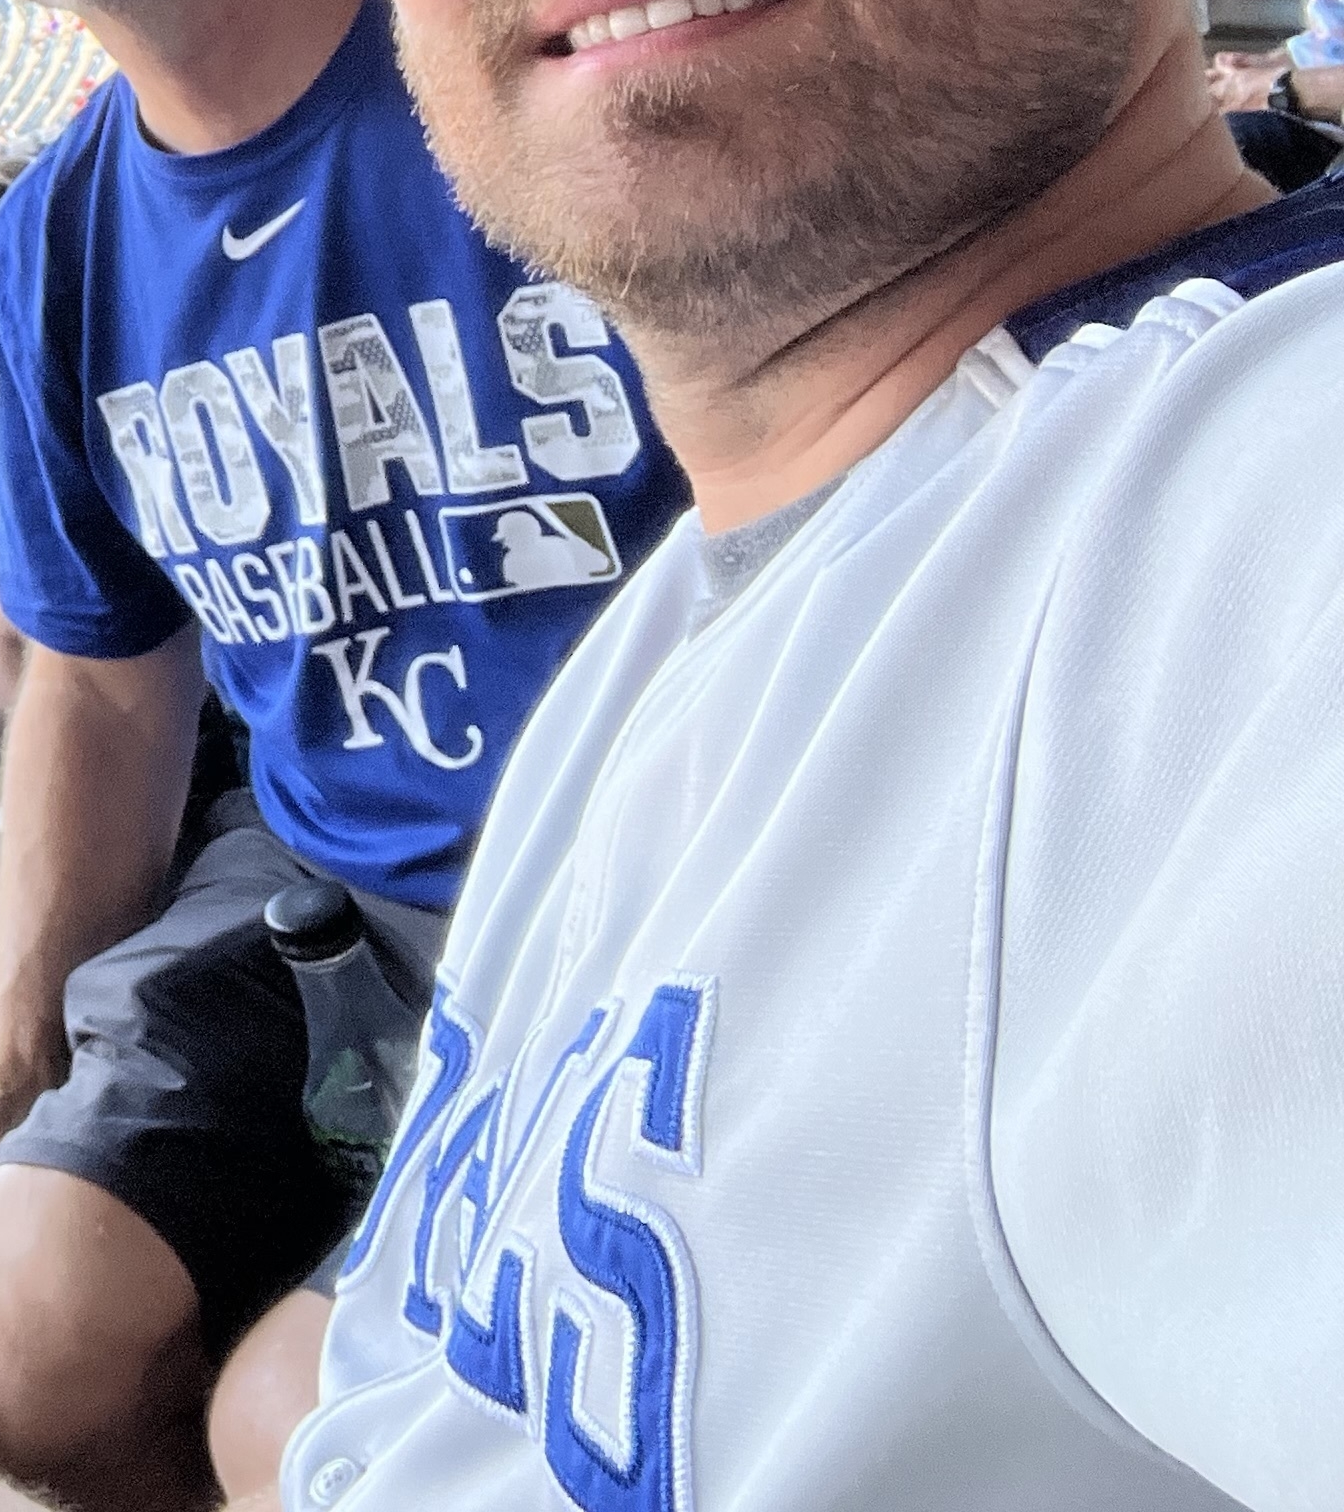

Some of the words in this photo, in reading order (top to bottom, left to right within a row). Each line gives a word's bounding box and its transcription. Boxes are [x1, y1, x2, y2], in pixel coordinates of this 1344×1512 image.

[97, 281, 642, 559] ROYALS
[175, 510, 457, 646] BASEBALL
[314, 626, 483, 769] KC
